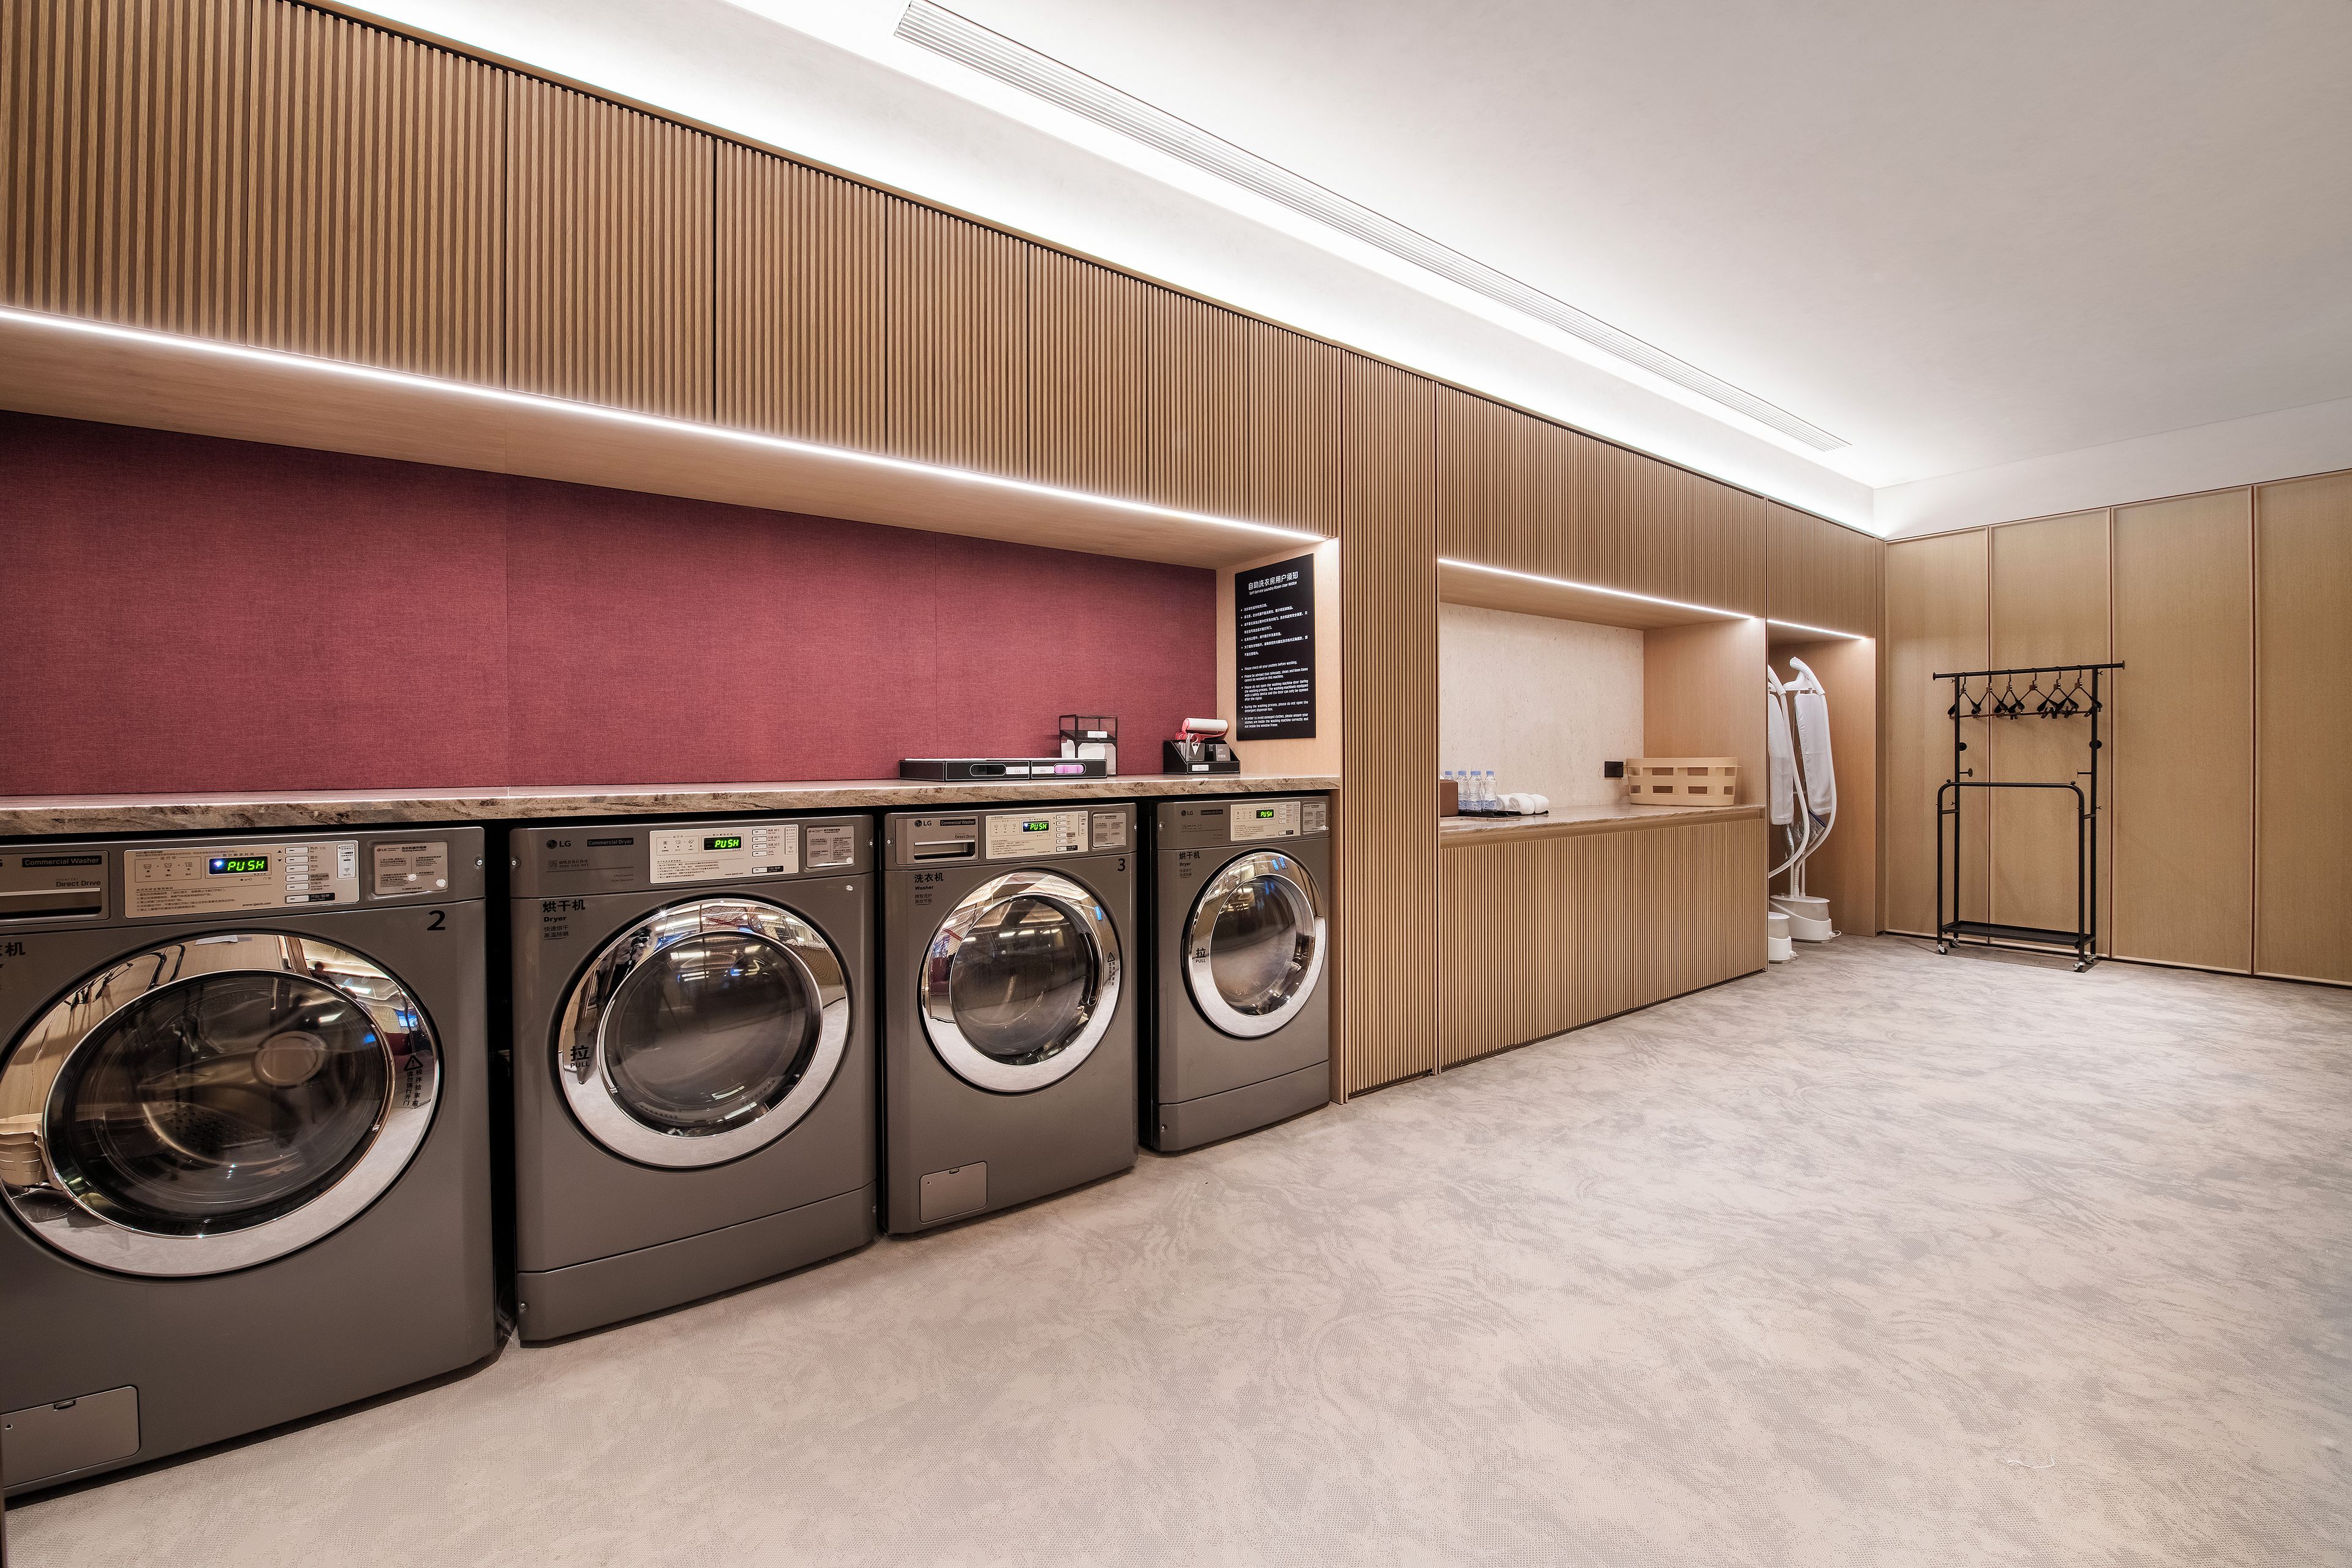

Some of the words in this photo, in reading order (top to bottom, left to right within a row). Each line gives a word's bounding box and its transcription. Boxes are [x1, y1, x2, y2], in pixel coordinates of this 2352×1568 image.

[1248, 571, 1298, 590] 自助洗衣房用户须知
[715, 839, 739, 848] PUSH
[227, 860, 265, 871] PUSH
[1117, 858, 1125, 872] 3
[914, 873, 943, 883] 洗衣机
[543, 899, 586, 913] 烘干机
[427, 910, 445, 930] 2
[1196, 948, 1205, 958] 拉
[570, 1045, 589, 1061] 拉
[403, 1071, 413, 1106] 请勿强行开门
[412, 1069, 422, 1107] 程序结束前
